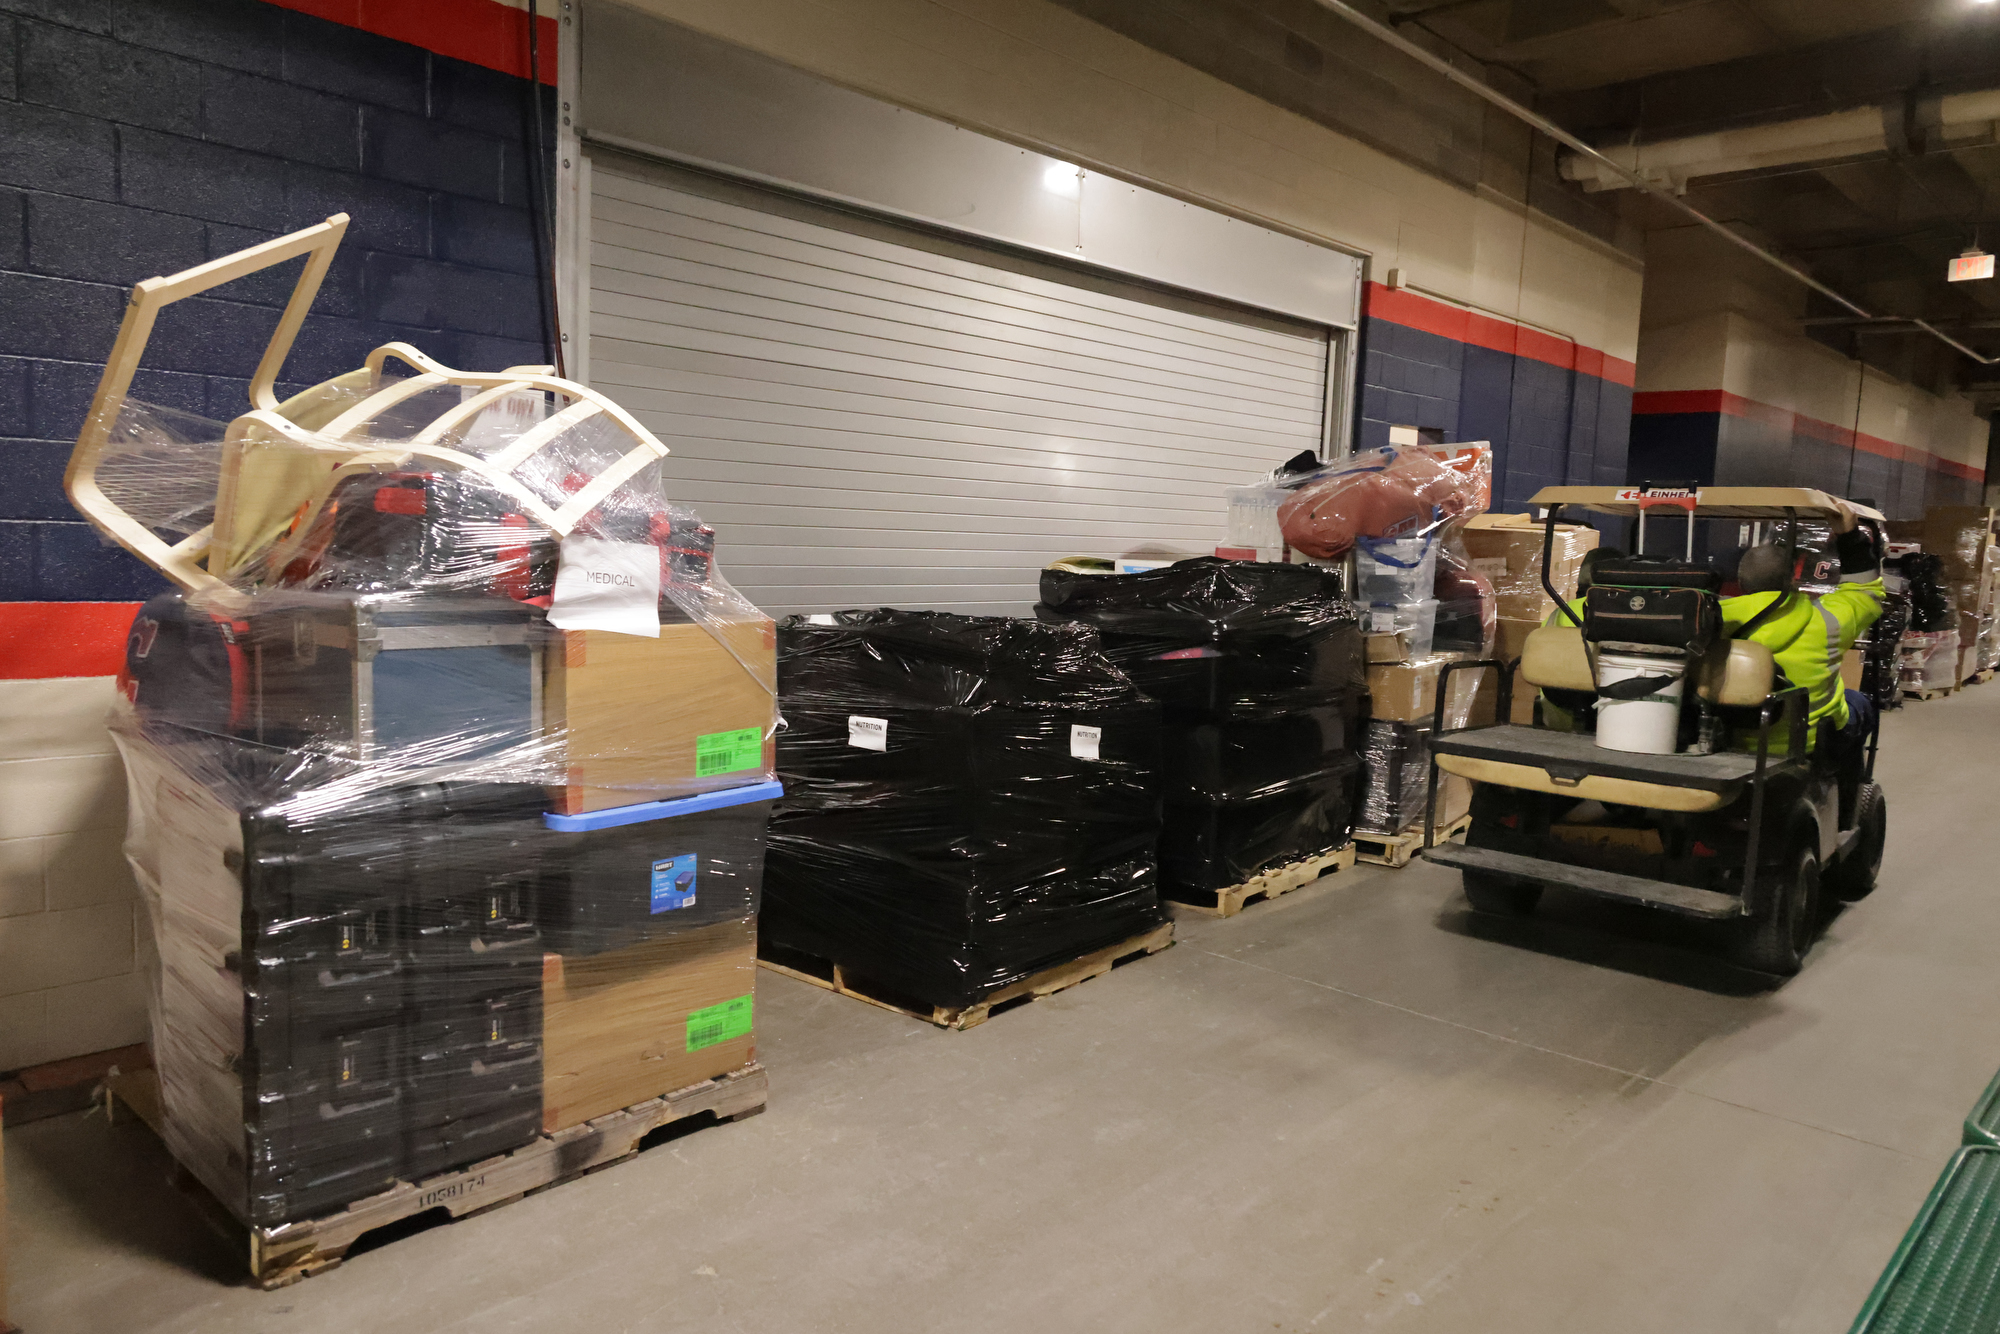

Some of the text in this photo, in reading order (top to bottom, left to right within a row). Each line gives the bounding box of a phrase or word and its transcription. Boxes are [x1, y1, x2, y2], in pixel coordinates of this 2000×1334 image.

[1955, 256, 1989, 279] EXIT
[586, 571, 635, 587] MEDICAL
[1813, 560, 1832, 580] C
[855, 721, 882, 731] NUTRITION
[1077, 731, 1098, 739] NUTRITION
[419, 1175, 485, 1208] 1058174
